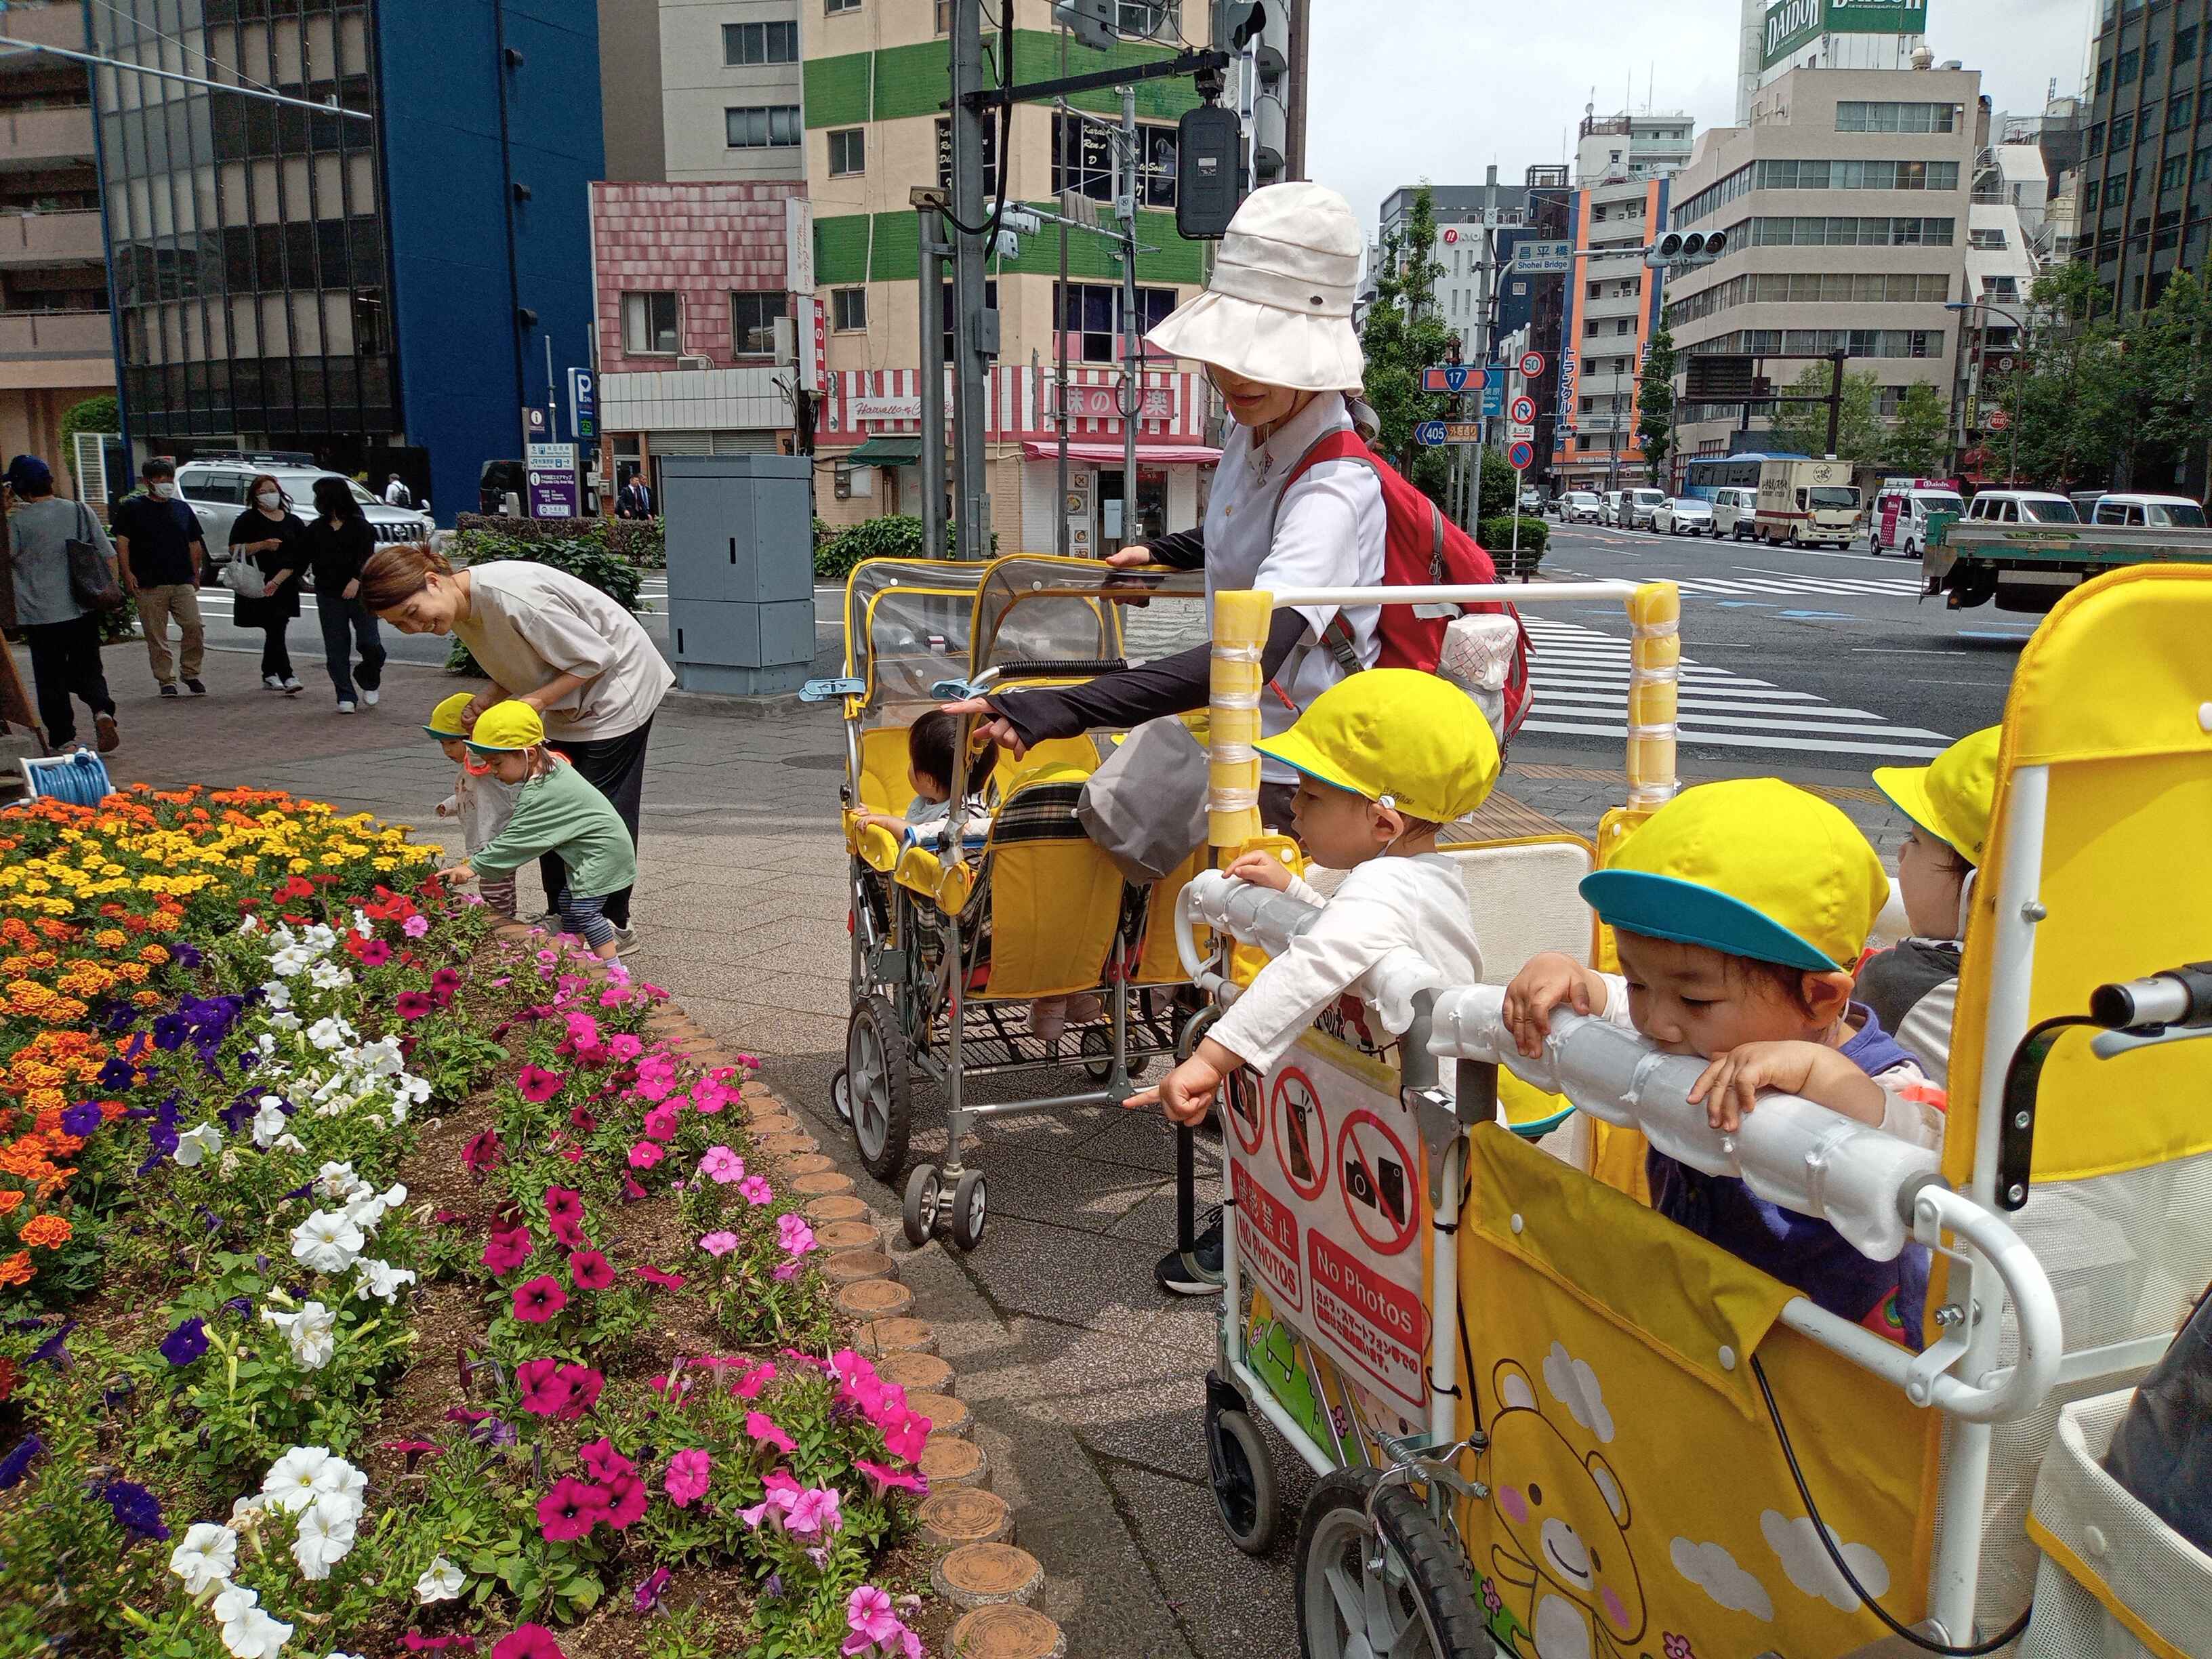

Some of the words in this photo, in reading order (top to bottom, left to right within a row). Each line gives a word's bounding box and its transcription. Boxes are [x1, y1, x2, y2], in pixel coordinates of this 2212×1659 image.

[1519, 245, 1569, 260] 昌平橋
[1517, 261, 1542, 270] Shohei
[1544, 260, 1568, 270] Bridge
[1525, 359, 1539, 370] 50
[1448, 372, 1462, 384] 17
[577, 374, 592, 402] P
[1067, 388, 1168, 415] 味の楽
[1426, 427, 1444, 440] 405
[1238, 1213, 1252, 1249] NO
[1252, 1231, 1297, 1296] PHOTOS
[1317, 1245, 1340, 1284] No
[1344, 1264, 1413, 1334] Photos
